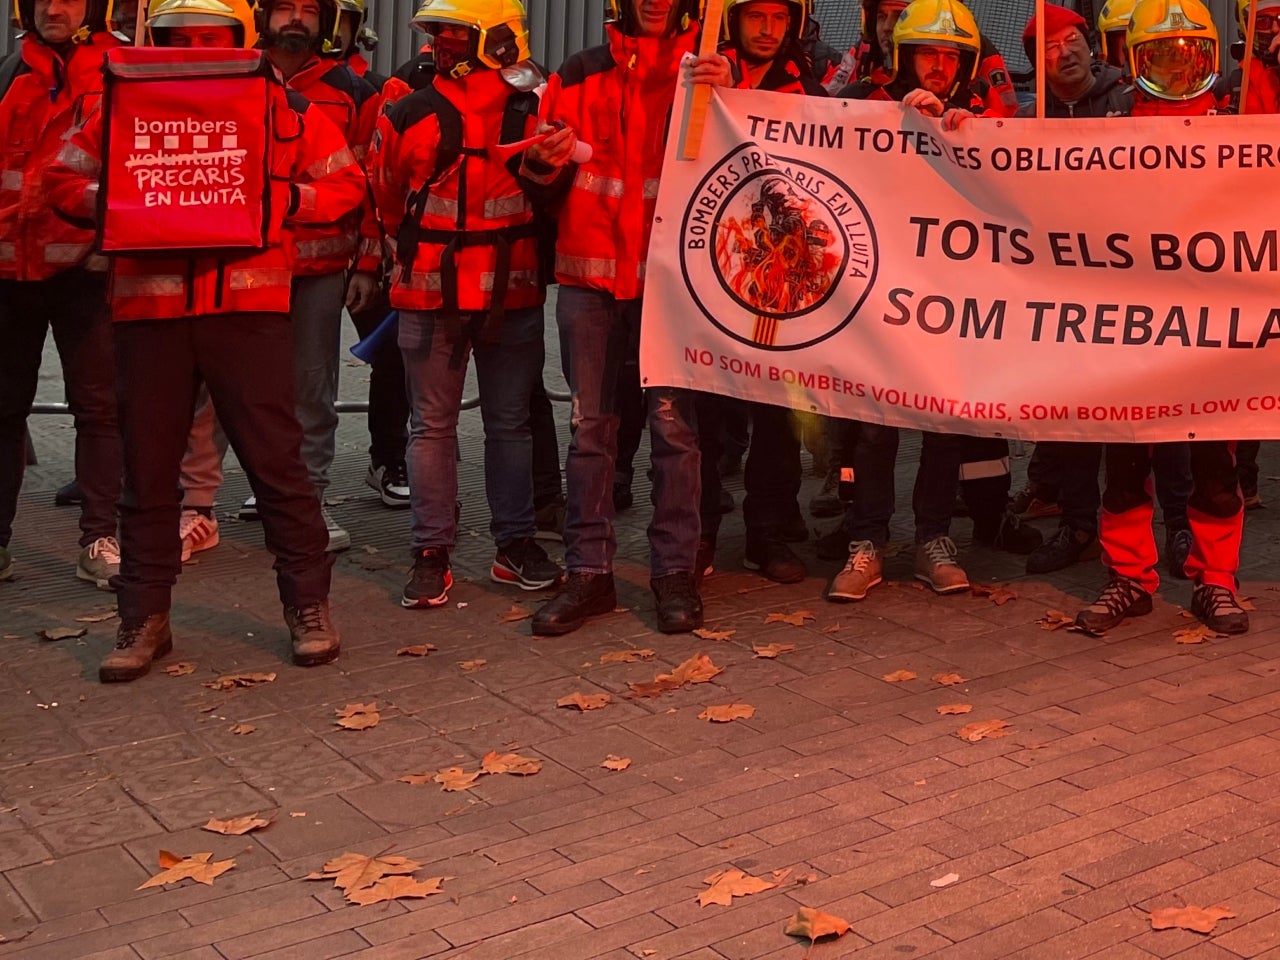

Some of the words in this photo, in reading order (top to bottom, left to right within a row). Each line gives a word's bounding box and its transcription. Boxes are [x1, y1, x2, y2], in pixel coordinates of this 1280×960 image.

[134, 117, 237, 134] bombers
[747, 115, 844, 149] TENIM
[854, 127, 942, 156] TOTES
[992, 145, 1206, 172] OBLIGACIONS
[145, 191, 171, 207] EN
[688, 164, 740, 249] BOMBERS
[827, 192, 852, 217] EN
[845, 222, 869, 279] LLUITA
[909, 216, 1035, 265] TOTS
[1048, 232, 1134, 269] ELS
[883, 288, 1007, 340] SOM
[684, 346, 714, 366] NO
[720, 355, 761, 379] SOM
[769, 366, 866, 397] BOMBERS
[871, 386, 1012, 422] VOLUNTARIS,
[1019, 404, 1069, 420] SOM
[1077, 404, 1183, 421] BOMBERS
[1190, 398, 1240, 414] LOW
